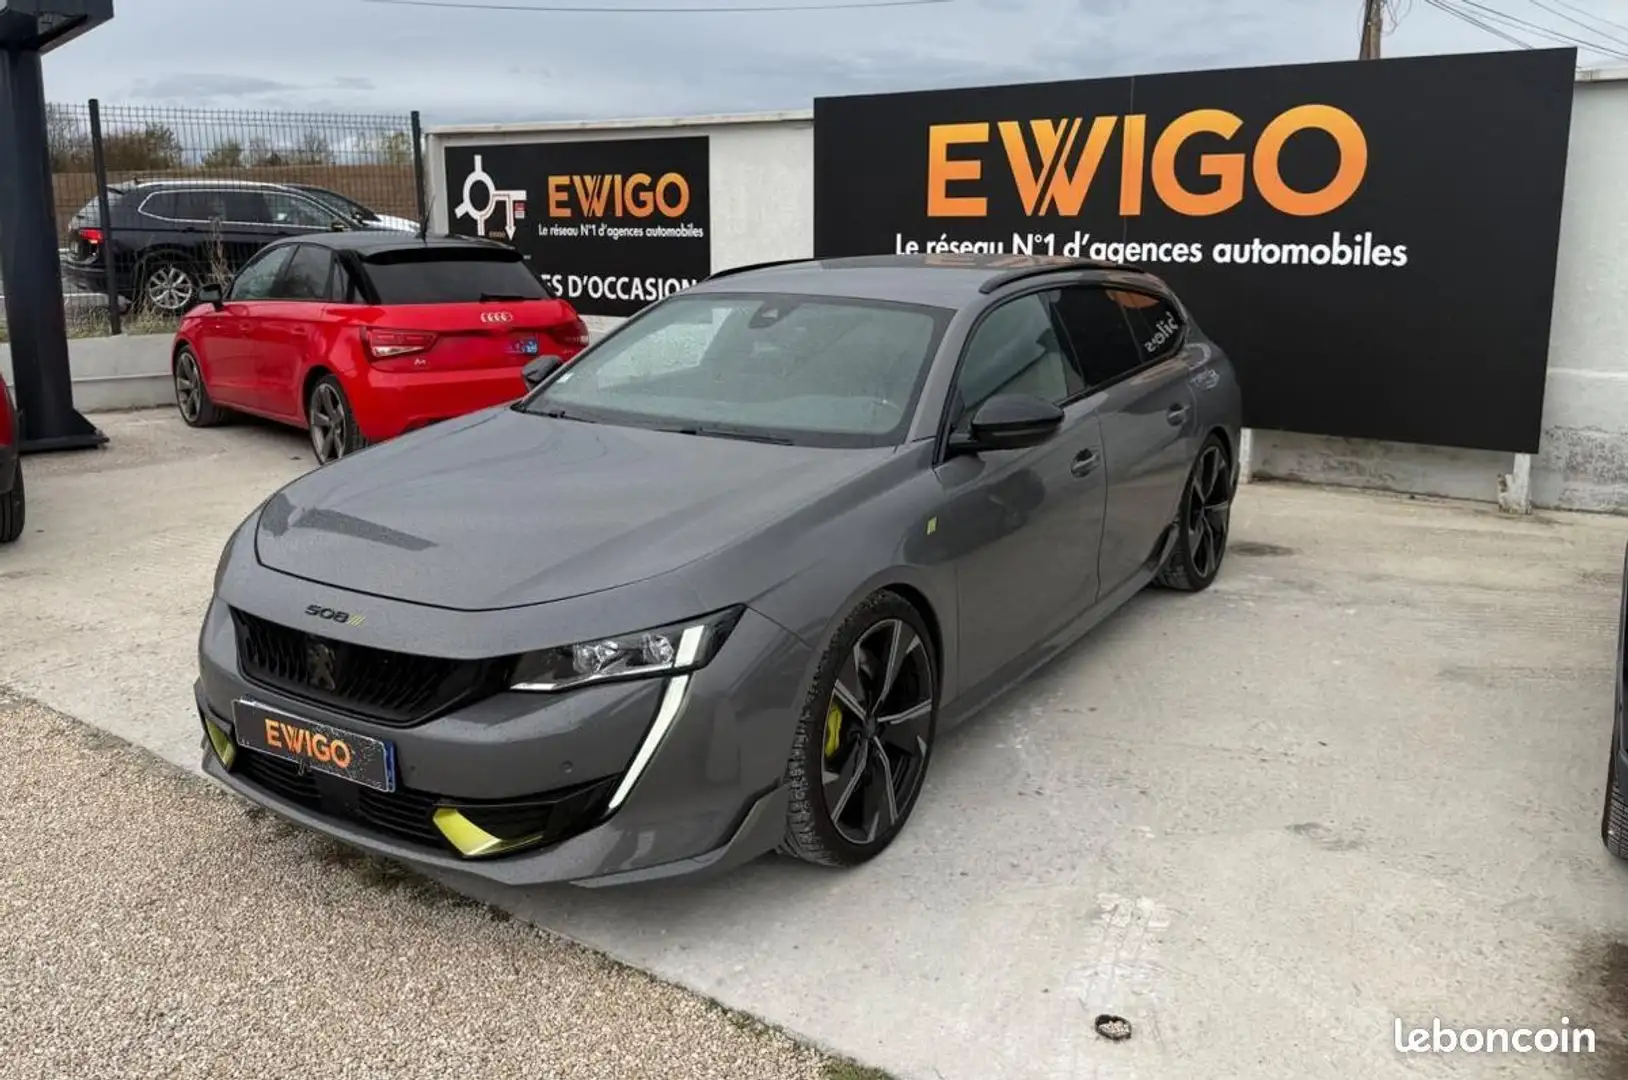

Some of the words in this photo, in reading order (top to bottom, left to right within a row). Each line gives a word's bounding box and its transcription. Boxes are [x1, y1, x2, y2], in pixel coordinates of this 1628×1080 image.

[926, 104, 1368, 217] EWIGO
[547, 172, 690, 218] EWIGO
[538, 223, 548, 236] Le
[549, 223, 578, 237] réseau
[580, 223, 596, 237] N°1
[598, 222, 643, 240] d'agences
[645, 222, 704, 238] automobiles
[896, 233, 919, 255] Le
[926, 233, 1003, 254] réseau
[1012, 233, 1055, 256] N°1
[1063, 231, 1203, 265] d'agences
[1212, 231, 1408, 267] automobiles
[304, 604, 349, 624] 508
[264, 718, 352, 769] EWIGO
